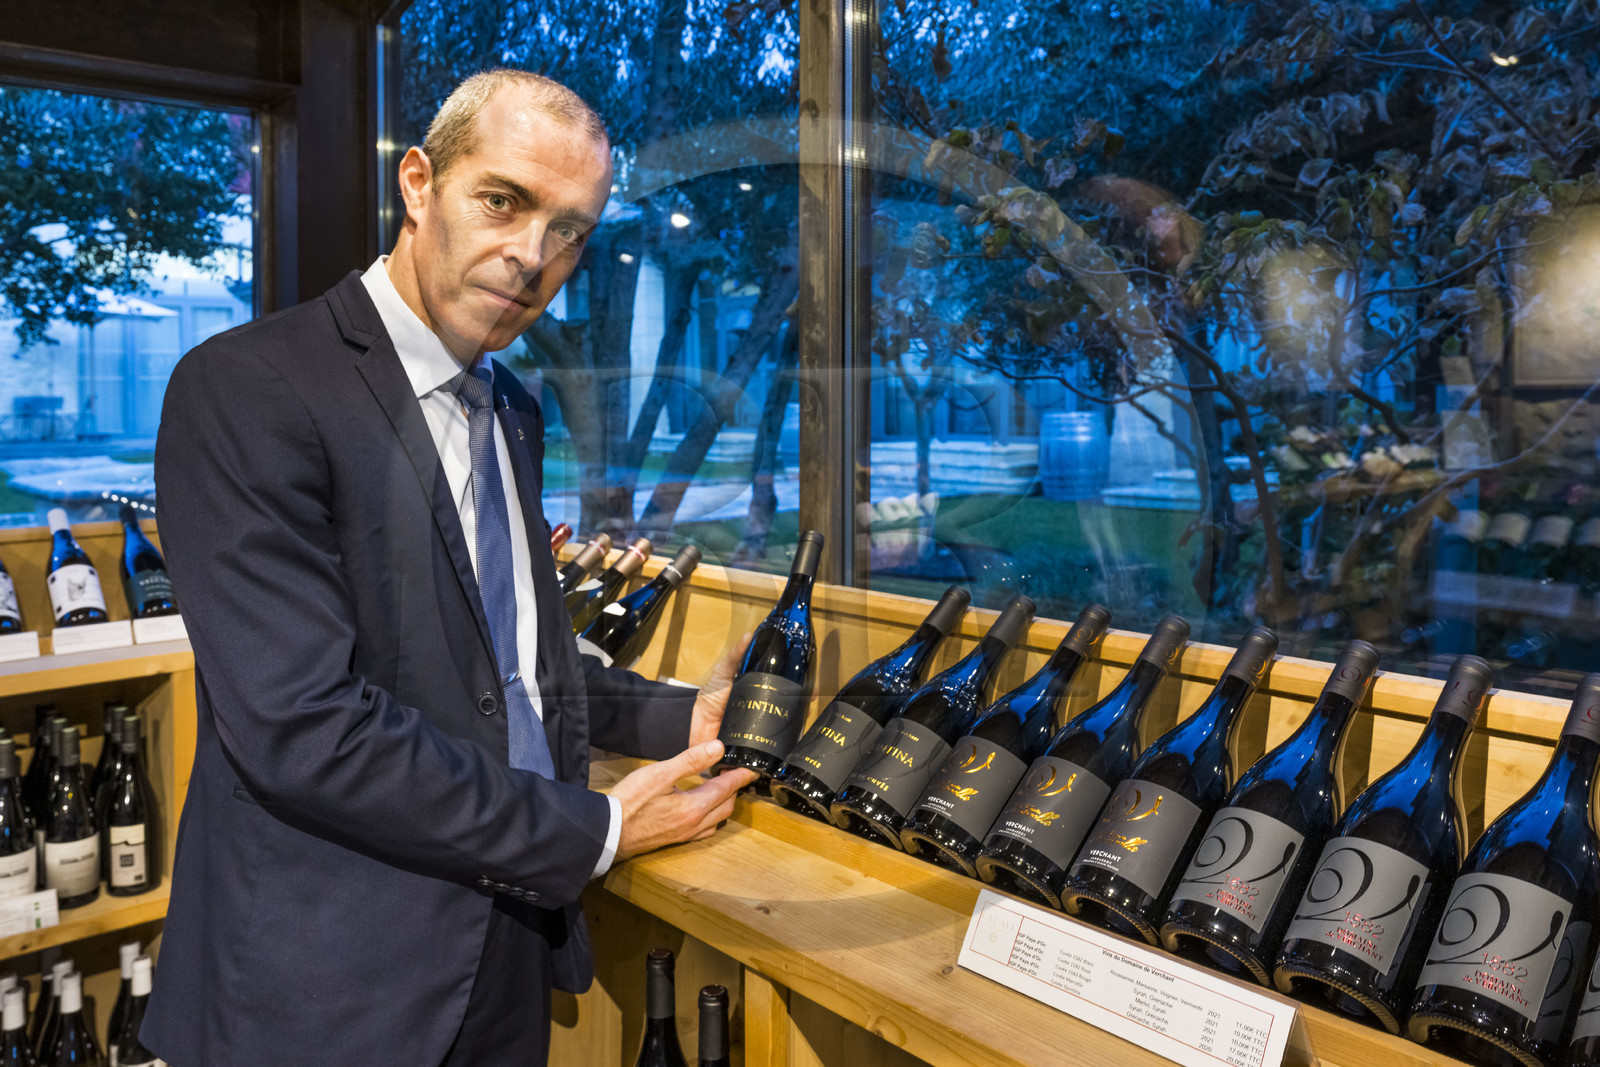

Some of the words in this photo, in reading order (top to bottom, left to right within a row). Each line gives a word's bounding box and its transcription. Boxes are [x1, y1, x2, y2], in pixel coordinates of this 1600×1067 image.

[927, 796, 955, 809] VERCHANT
[1005, 821, 1035, 835] VERCHANT
[1090, 849, 1121, 863] VERCHANT
[1216, 888, 1251, 910] DOMAINE
[1224, 874, 1260, 901] 1582
[1216, 895, 1256, 920] VERCHANT
[1336, 927, 1379, 951] DOMAINE
[1344, 911, 1385, 941] 1582
[1337, 934, 1383, 962] VERCHANT
[1102, 949, 1112, 958] Vins
[1120, 957, 1143, 970] Domaine
[1151, 969, 1175, 982] Verchant
[1482, 953, 1528, 984] 1582
[1024, 942, 1034, 951] Pays
[1205, 1018, 1218, 1028] 2021
[1253, 1037, 1265, 1048] TTC
[1026, 935, 1036, 944] Pays
[1207, 1009, 1221, 1019] 2021
[1255, 1028, 1268, 1039] TTC
[1462, 975, 1473, 983] de
[1475, 978, 1528, 1007] VERCHANT
[1474, 970, 1523, 996] DOMAINE
[1017, 963, 1027, 972] Pays
[1198, 1043, 1213, 1053] 2020
[1019, 956, 1029, 965] Pays
[1201, 1035, 1214, 1045] 2021
[1249, 1055, 1261, 1065] TTC
[1021, 949, 1032, 958] Pays
[1203, 1026, 1216, 1036] 2021
[1251, 1046, 1263, 1057] TTC
